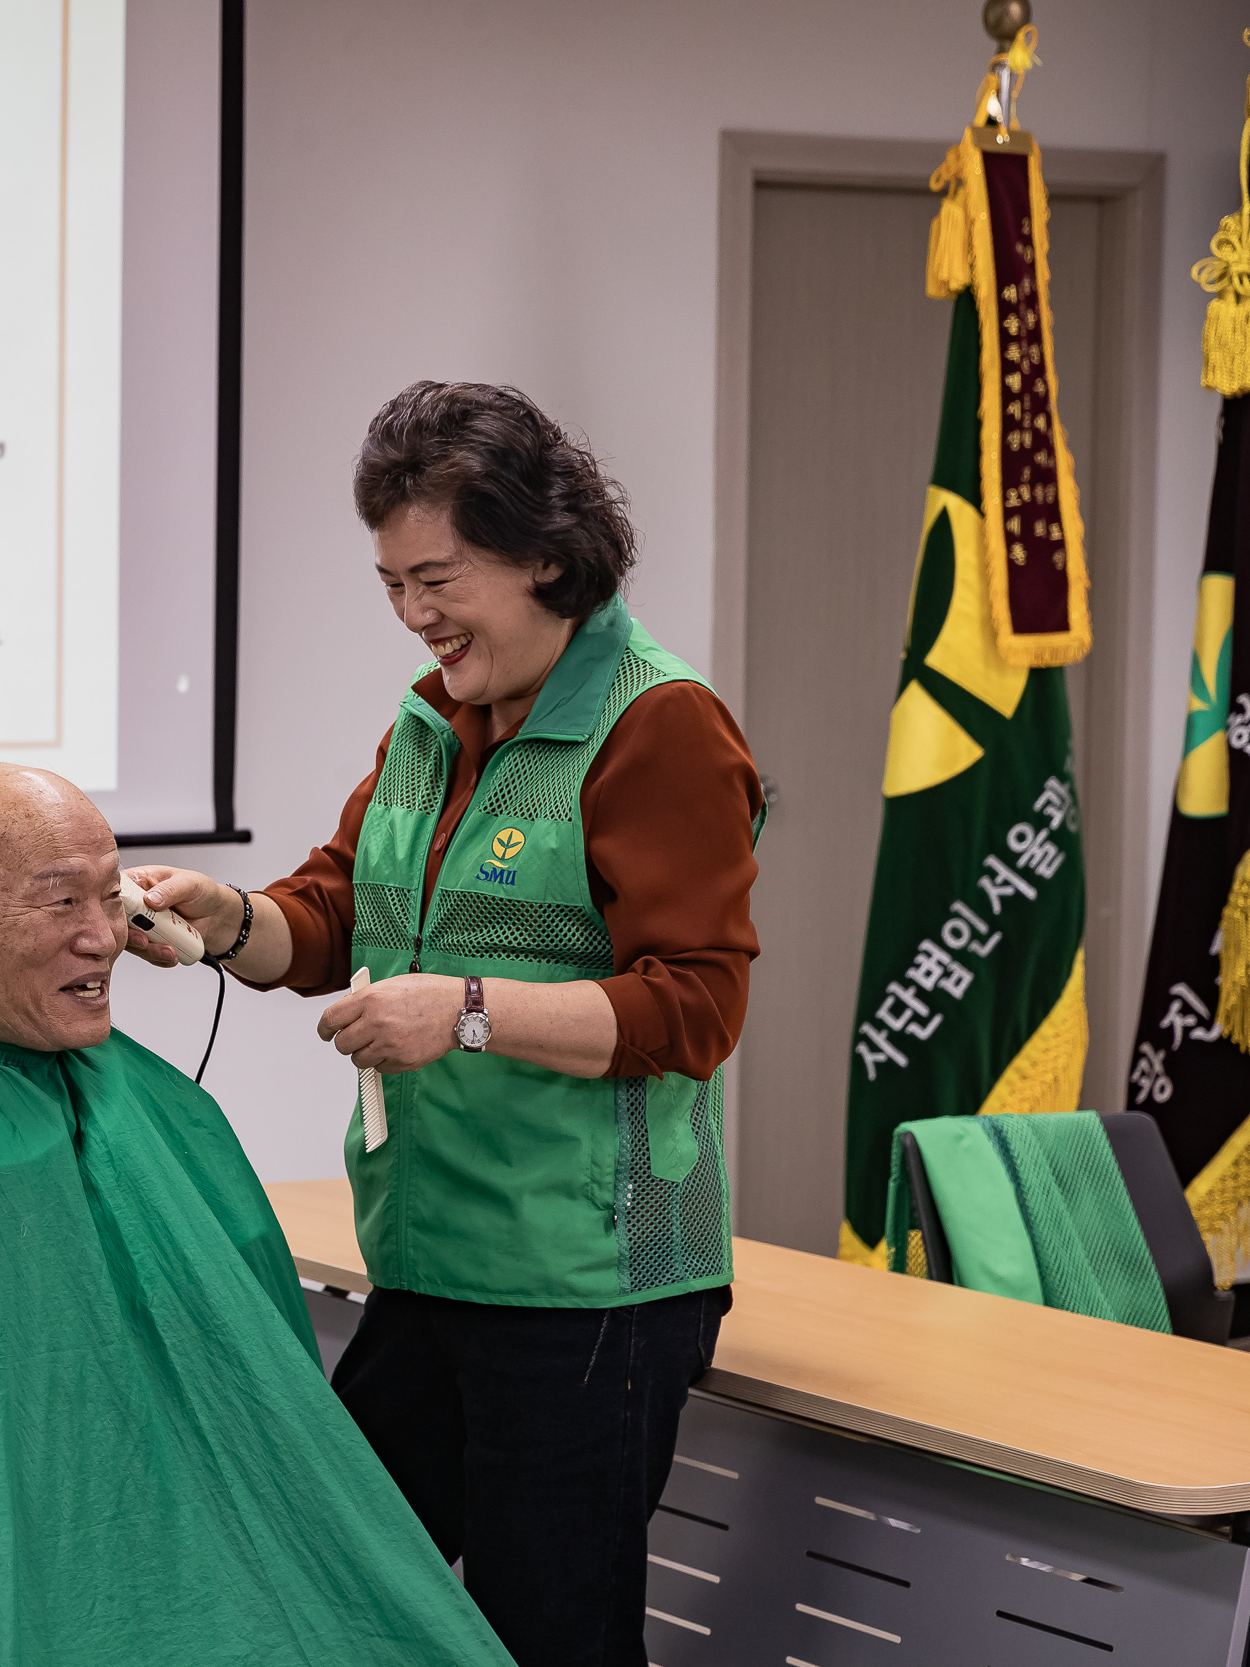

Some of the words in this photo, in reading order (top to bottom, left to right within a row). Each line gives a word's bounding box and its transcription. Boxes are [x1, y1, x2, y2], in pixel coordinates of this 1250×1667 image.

[476, 863, 518, 886] SMU
[855, 899, 1003, 1082] 사단법인
[977, 755, 1080, 916] 서울광
